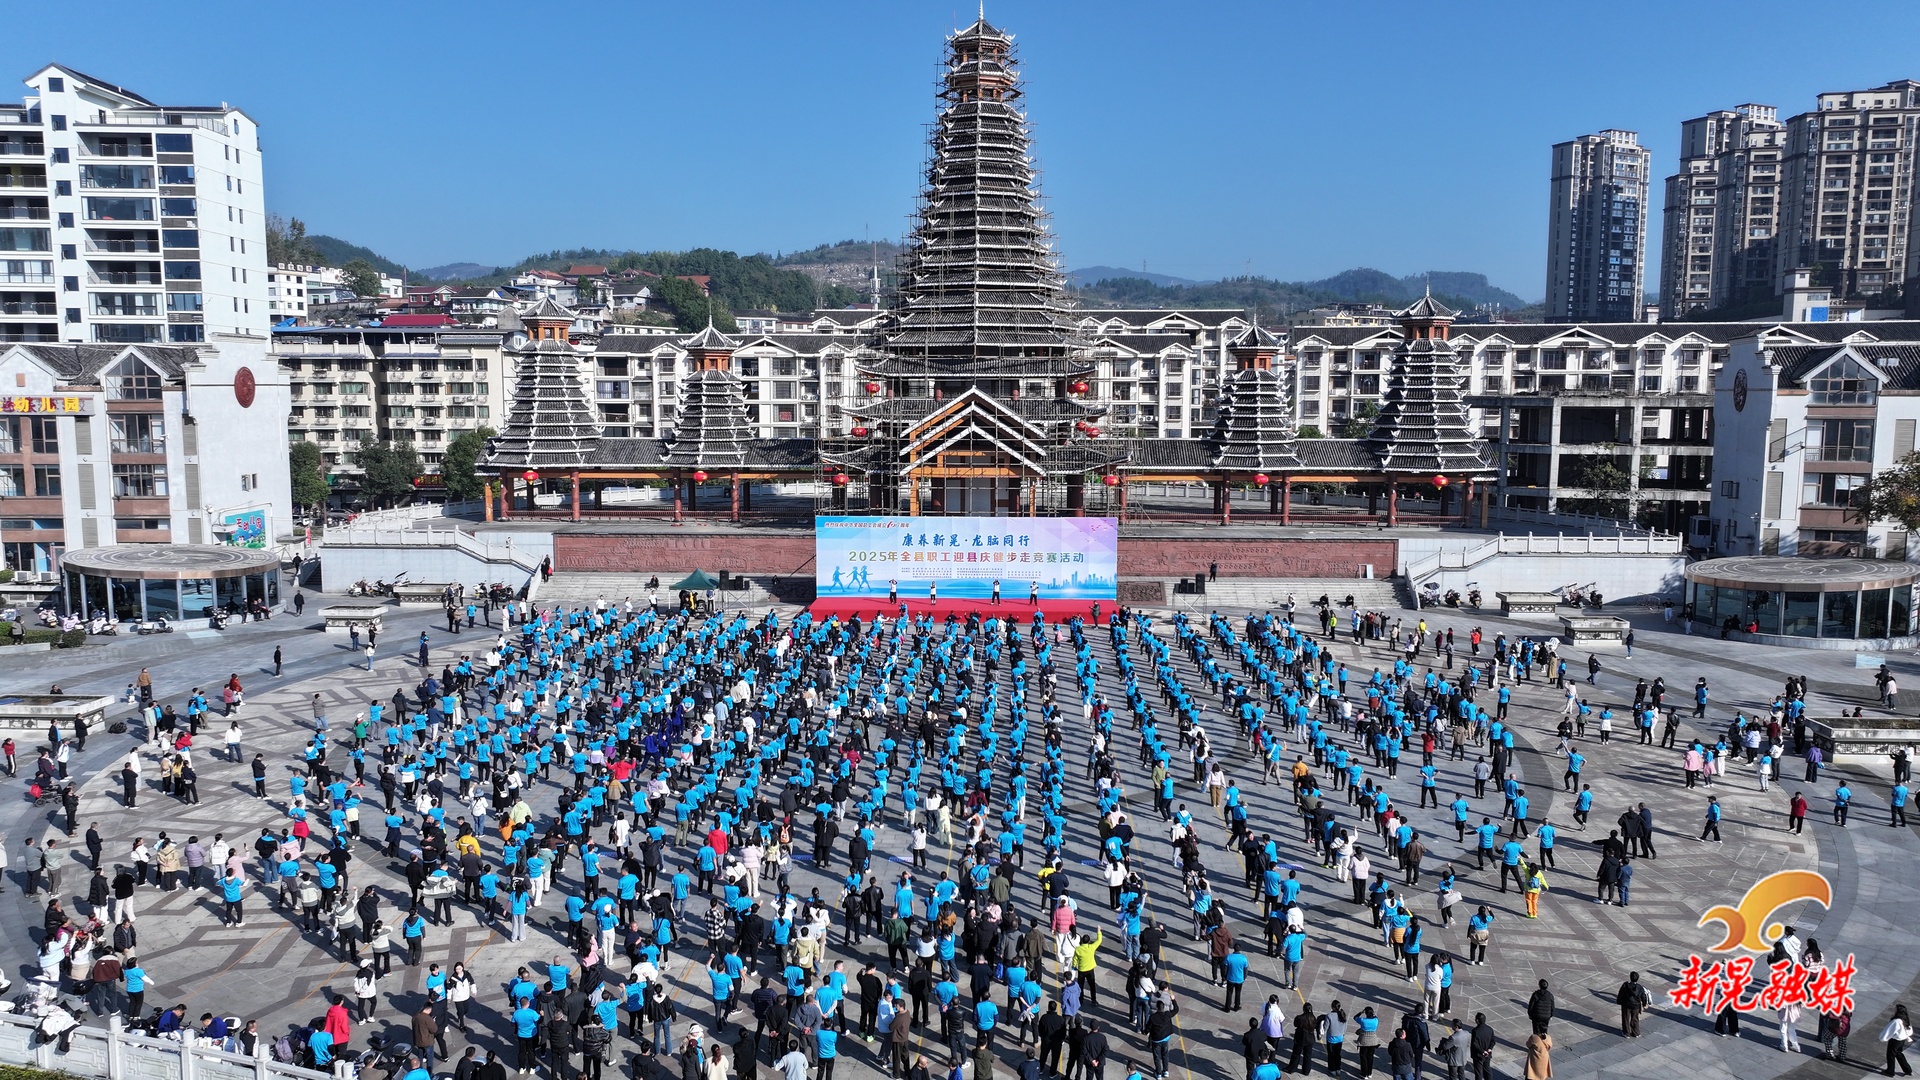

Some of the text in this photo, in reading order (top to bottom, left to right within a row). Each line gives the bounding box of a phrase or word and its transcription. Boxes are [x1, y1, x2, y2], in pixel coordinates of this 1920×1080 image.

[0, 396, 79, 413] 幼儿园
[902, 532, 1030, 548] 康养新晃·龙脑同行
[849, 551, 1085, 563] 2025年全县职工迎县庆健步走竞赛活动
